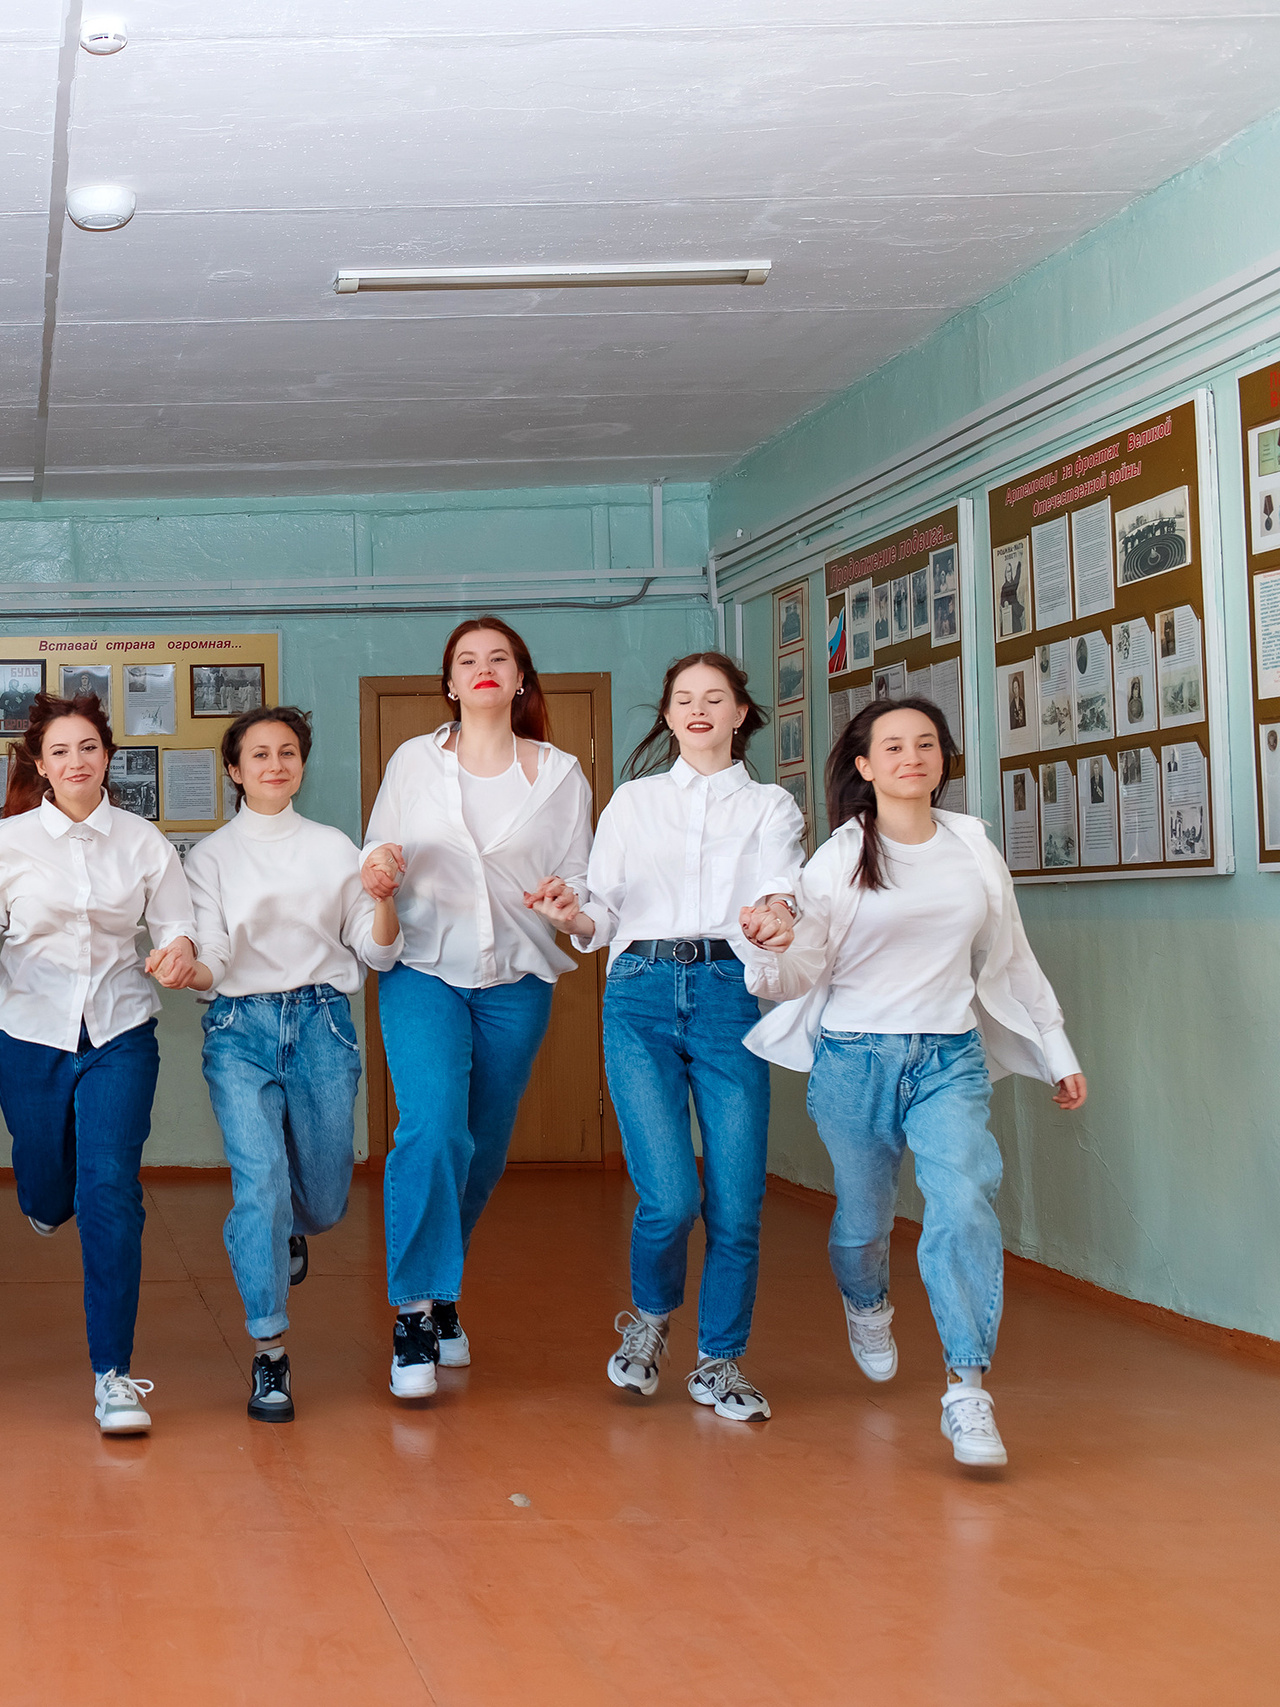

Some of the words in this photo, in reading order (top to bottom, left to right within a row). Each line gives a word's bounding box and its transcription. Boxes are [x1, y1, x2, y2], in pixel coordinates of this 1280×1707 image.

[1005, 470, 1058, 507] Артемовцы
[1061, 463, 1073, 481] на
[1074, 442, 1120, 479] фронтах
[1127, 415, 1173, 453] Великой
[1032, 470, 1107, 518] Отечественной
[1108, 460, 1142, 486] войны
[830, 545, 897, 592] Продолжение
[38, 639, 98, 652] Вставай
[105, 640, 156, 653] страна
[167, 640, 242, 652] огромная...
[10, 667, 39, 678] БУДЬ
[0, 719, 31, 731] ГЕРОЕ
